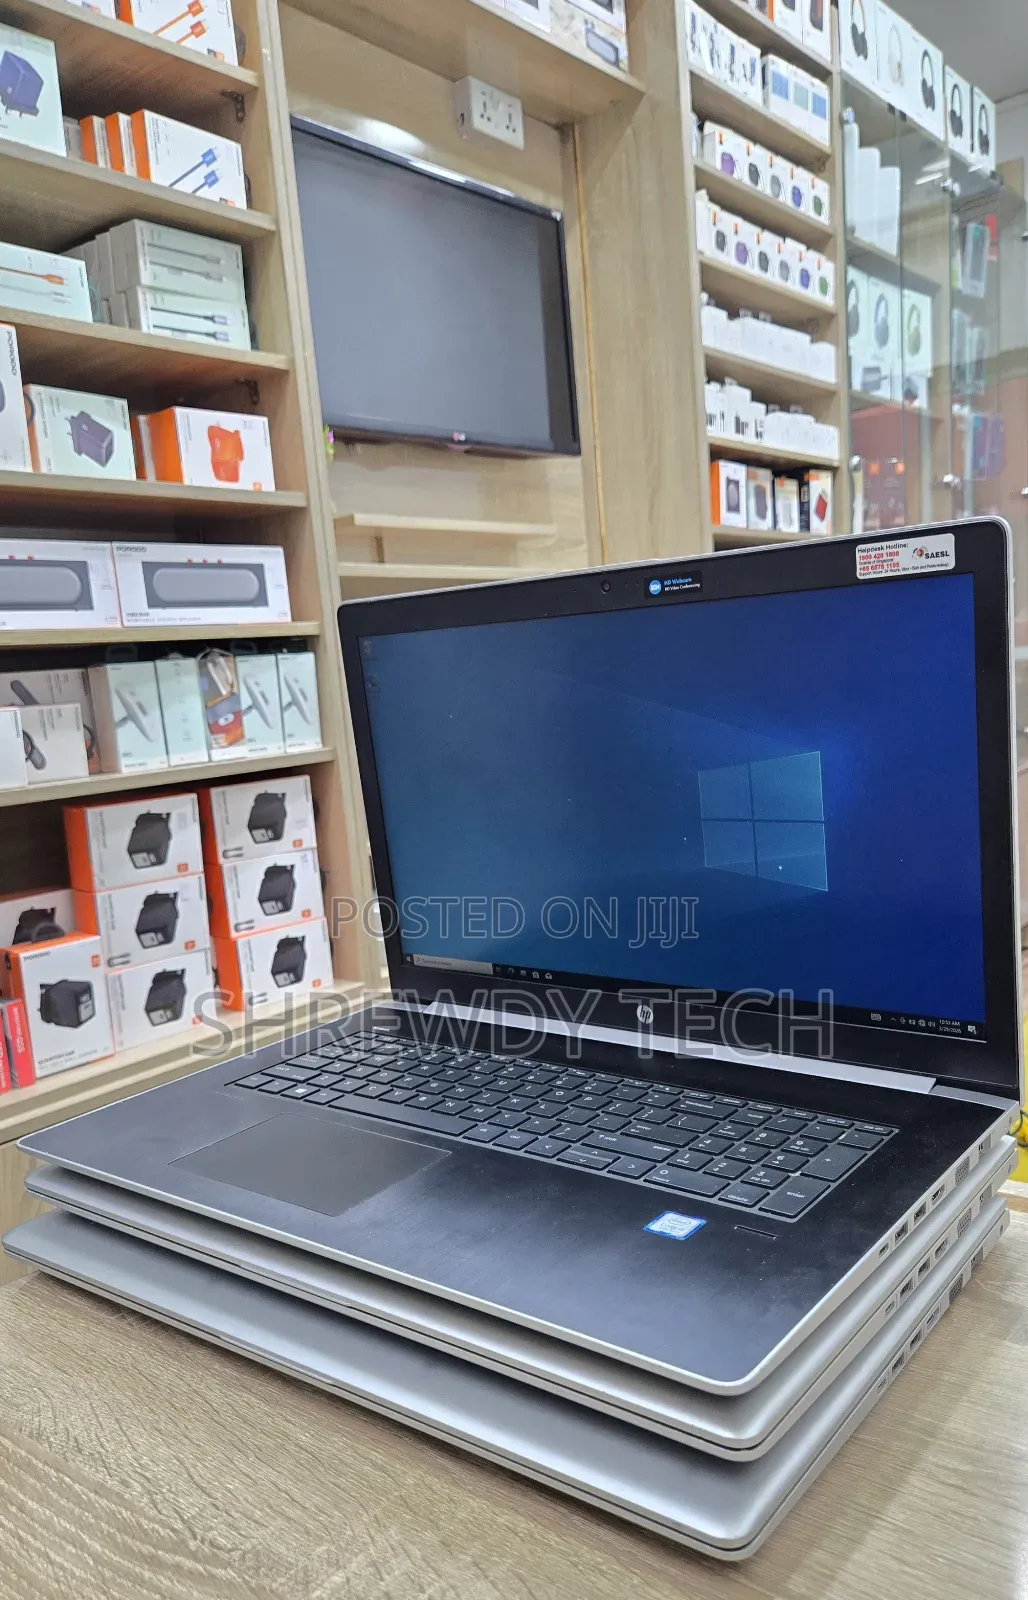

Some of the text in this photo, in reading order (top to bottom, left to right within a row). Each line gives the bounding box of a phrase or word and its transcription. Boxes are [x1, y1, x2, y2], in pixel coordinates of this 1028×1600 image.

[6, 331, 17, 376] PORODO
[858, 545, 884, 554] Helpdesk
[924, 550, 950, 560] SAESL
[786, 1190, 805, 1198] enter
